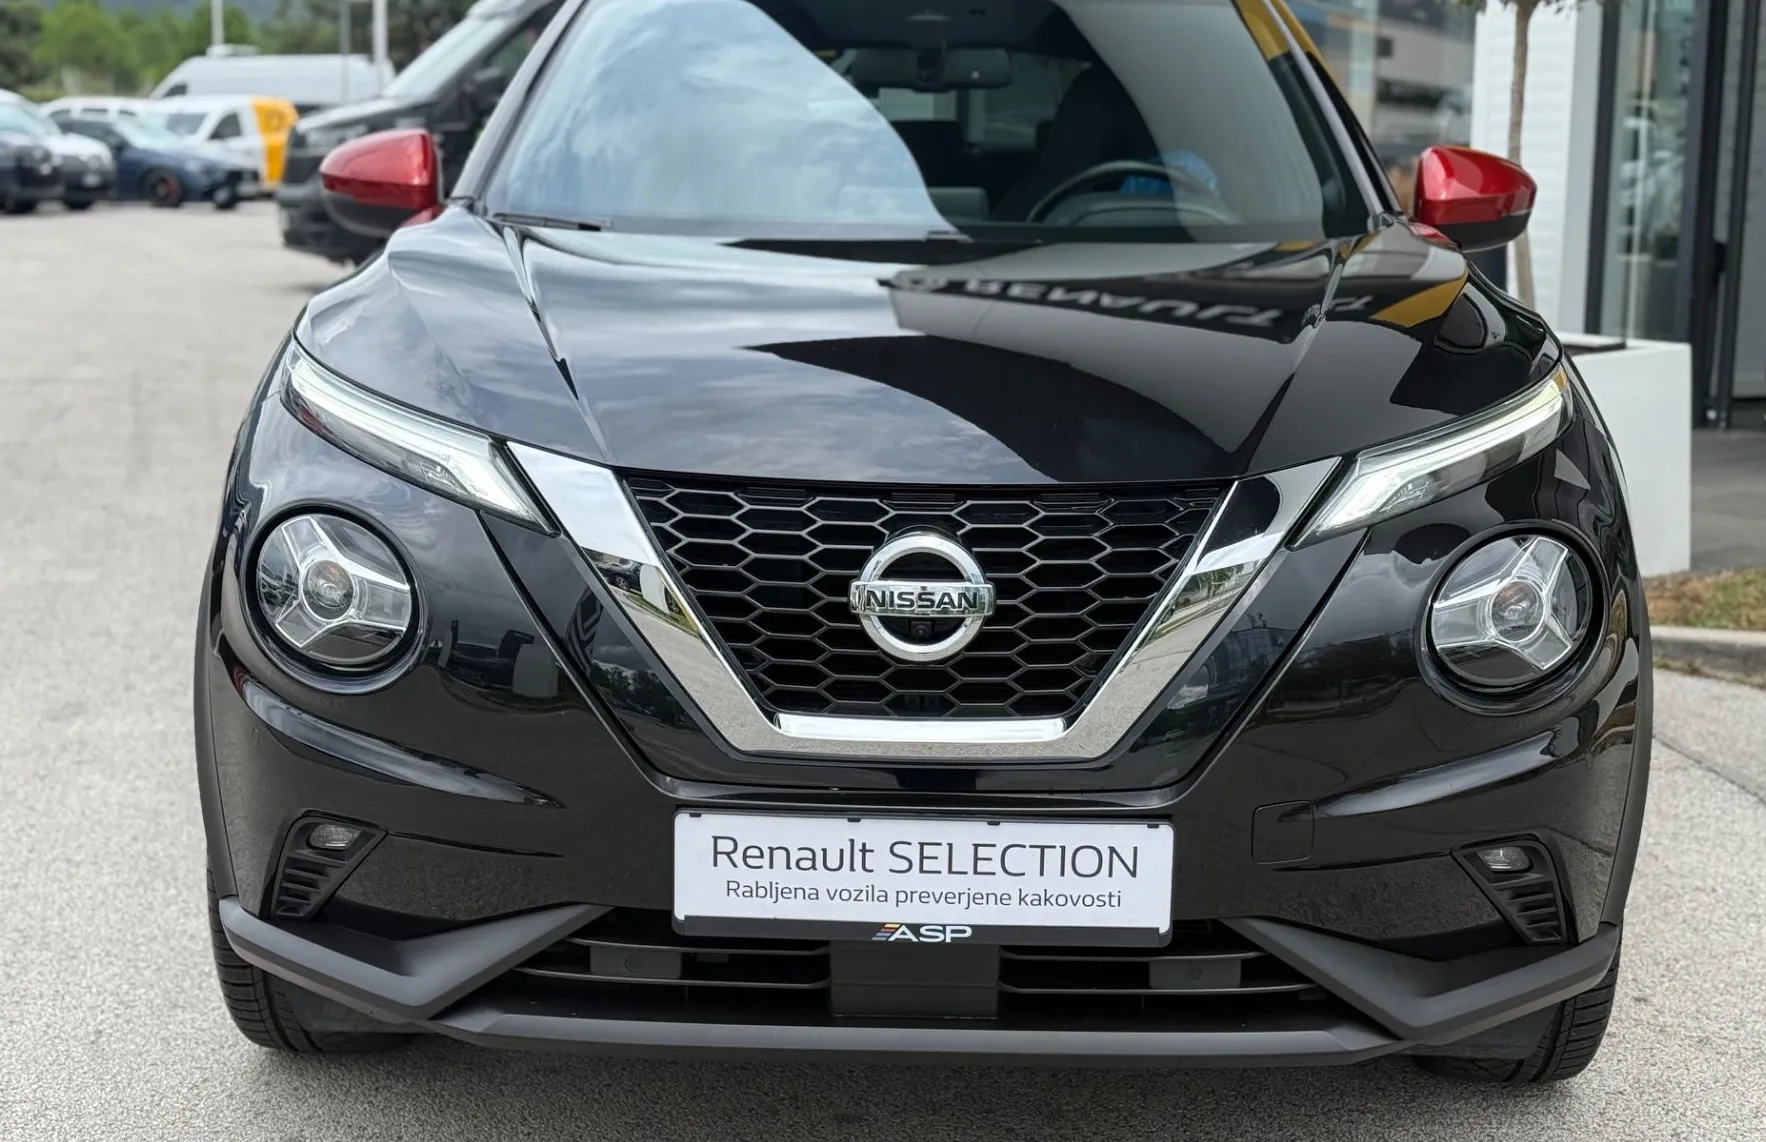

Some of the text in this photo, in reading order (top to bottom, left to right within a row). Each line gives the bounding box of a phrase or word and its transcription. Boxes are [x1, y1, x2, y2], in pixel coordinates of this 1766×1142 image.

[865, 590, 978, 610] NISSAN
[711, 835, 1138, 879] Renault SELECTION
[726, 880, 1122, 910] Rabljena vozila preverjene kakovosti
[888, 925, 973, 942] ASP
